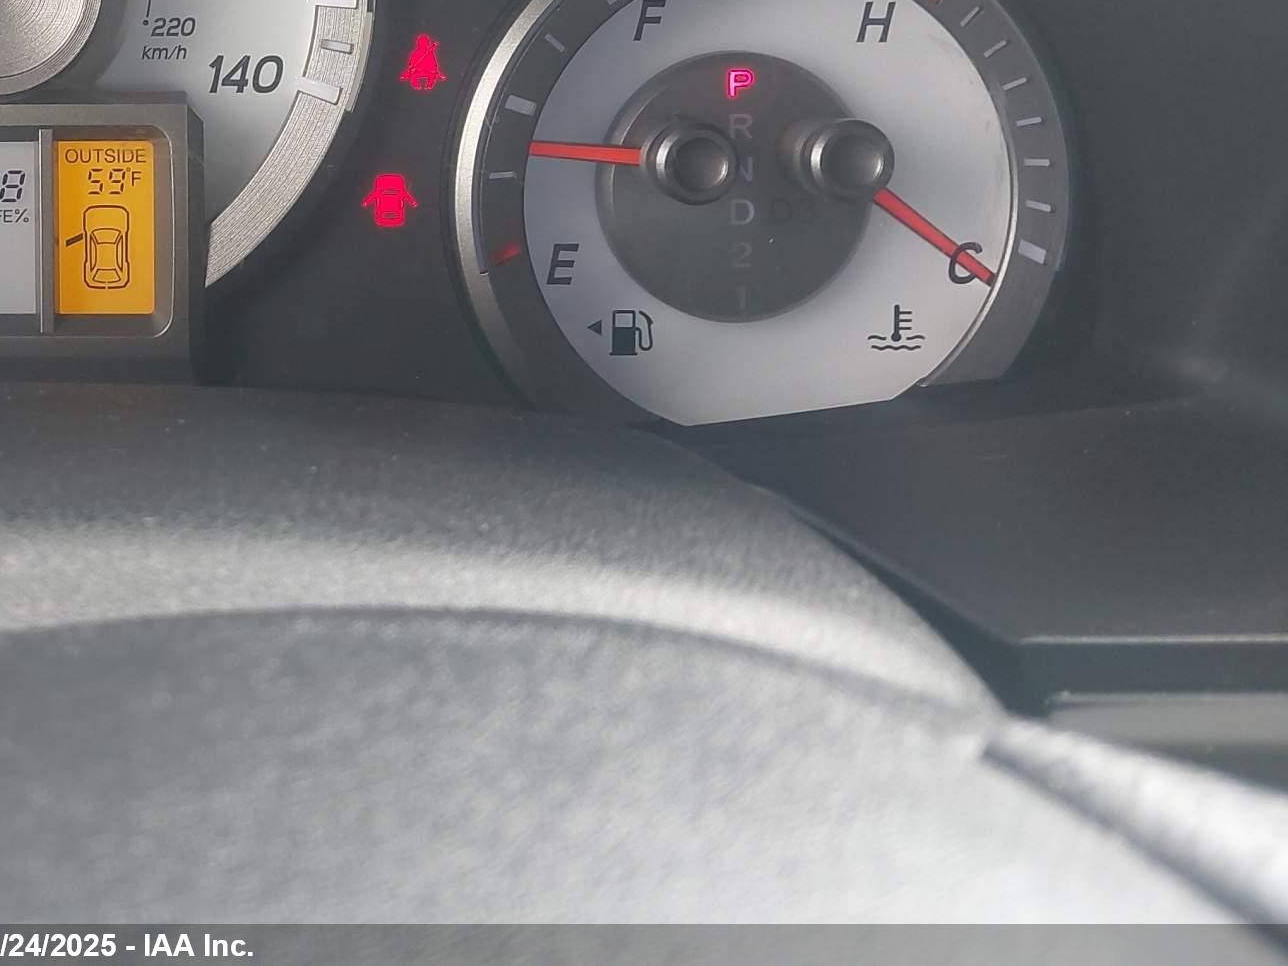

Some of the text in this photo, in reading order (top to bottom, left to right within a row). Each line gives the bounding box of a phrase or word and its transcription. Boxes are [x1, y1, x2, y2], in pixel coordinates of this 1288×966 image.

[151, 17, 196, 37] 220
[632, 0, 666, 42] F
[856, 1, 896, 43] H
[141, 45, 187, 61] km/h
[208, 54, 284, 95] 140
[727, 69, 755, 98] P
[729, 113, 753, 139] R
[64, 148, 147, 164] OUTSIDE
[730, 198, 755, 225] D
[546, 243, 580, 286] E
[732, 242, 753, 268] 2
[948, 241, 985, 285] C
